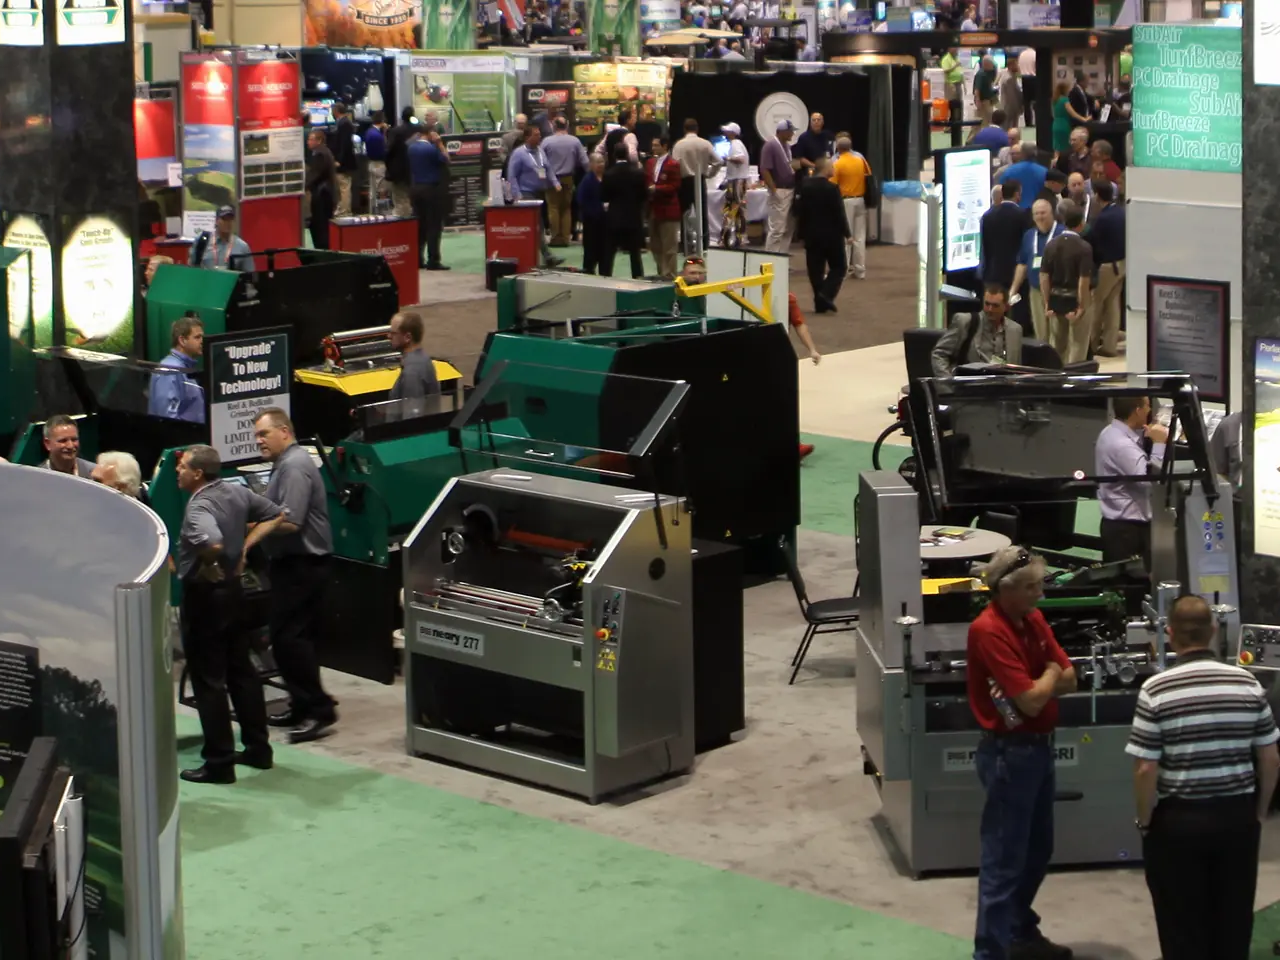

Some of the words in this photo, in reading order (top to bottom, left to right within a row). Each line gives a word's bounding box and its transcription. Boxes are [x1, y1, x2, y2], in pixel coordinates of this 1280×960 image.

[1134, 25, 1182, 43] SubAir
[1152, 67, 1219, 93] Drainage
[1132, 109, 1211, 132] TurfBreeze
[1147, 133, 1169, 157] PC
[233, 363, 245, 375] To
[246, 361, 268, 374] New
[220, 375, 281, 395] Technology!
[433, 629, 460, 645] neary
[463, 636, 480, 650] 277
